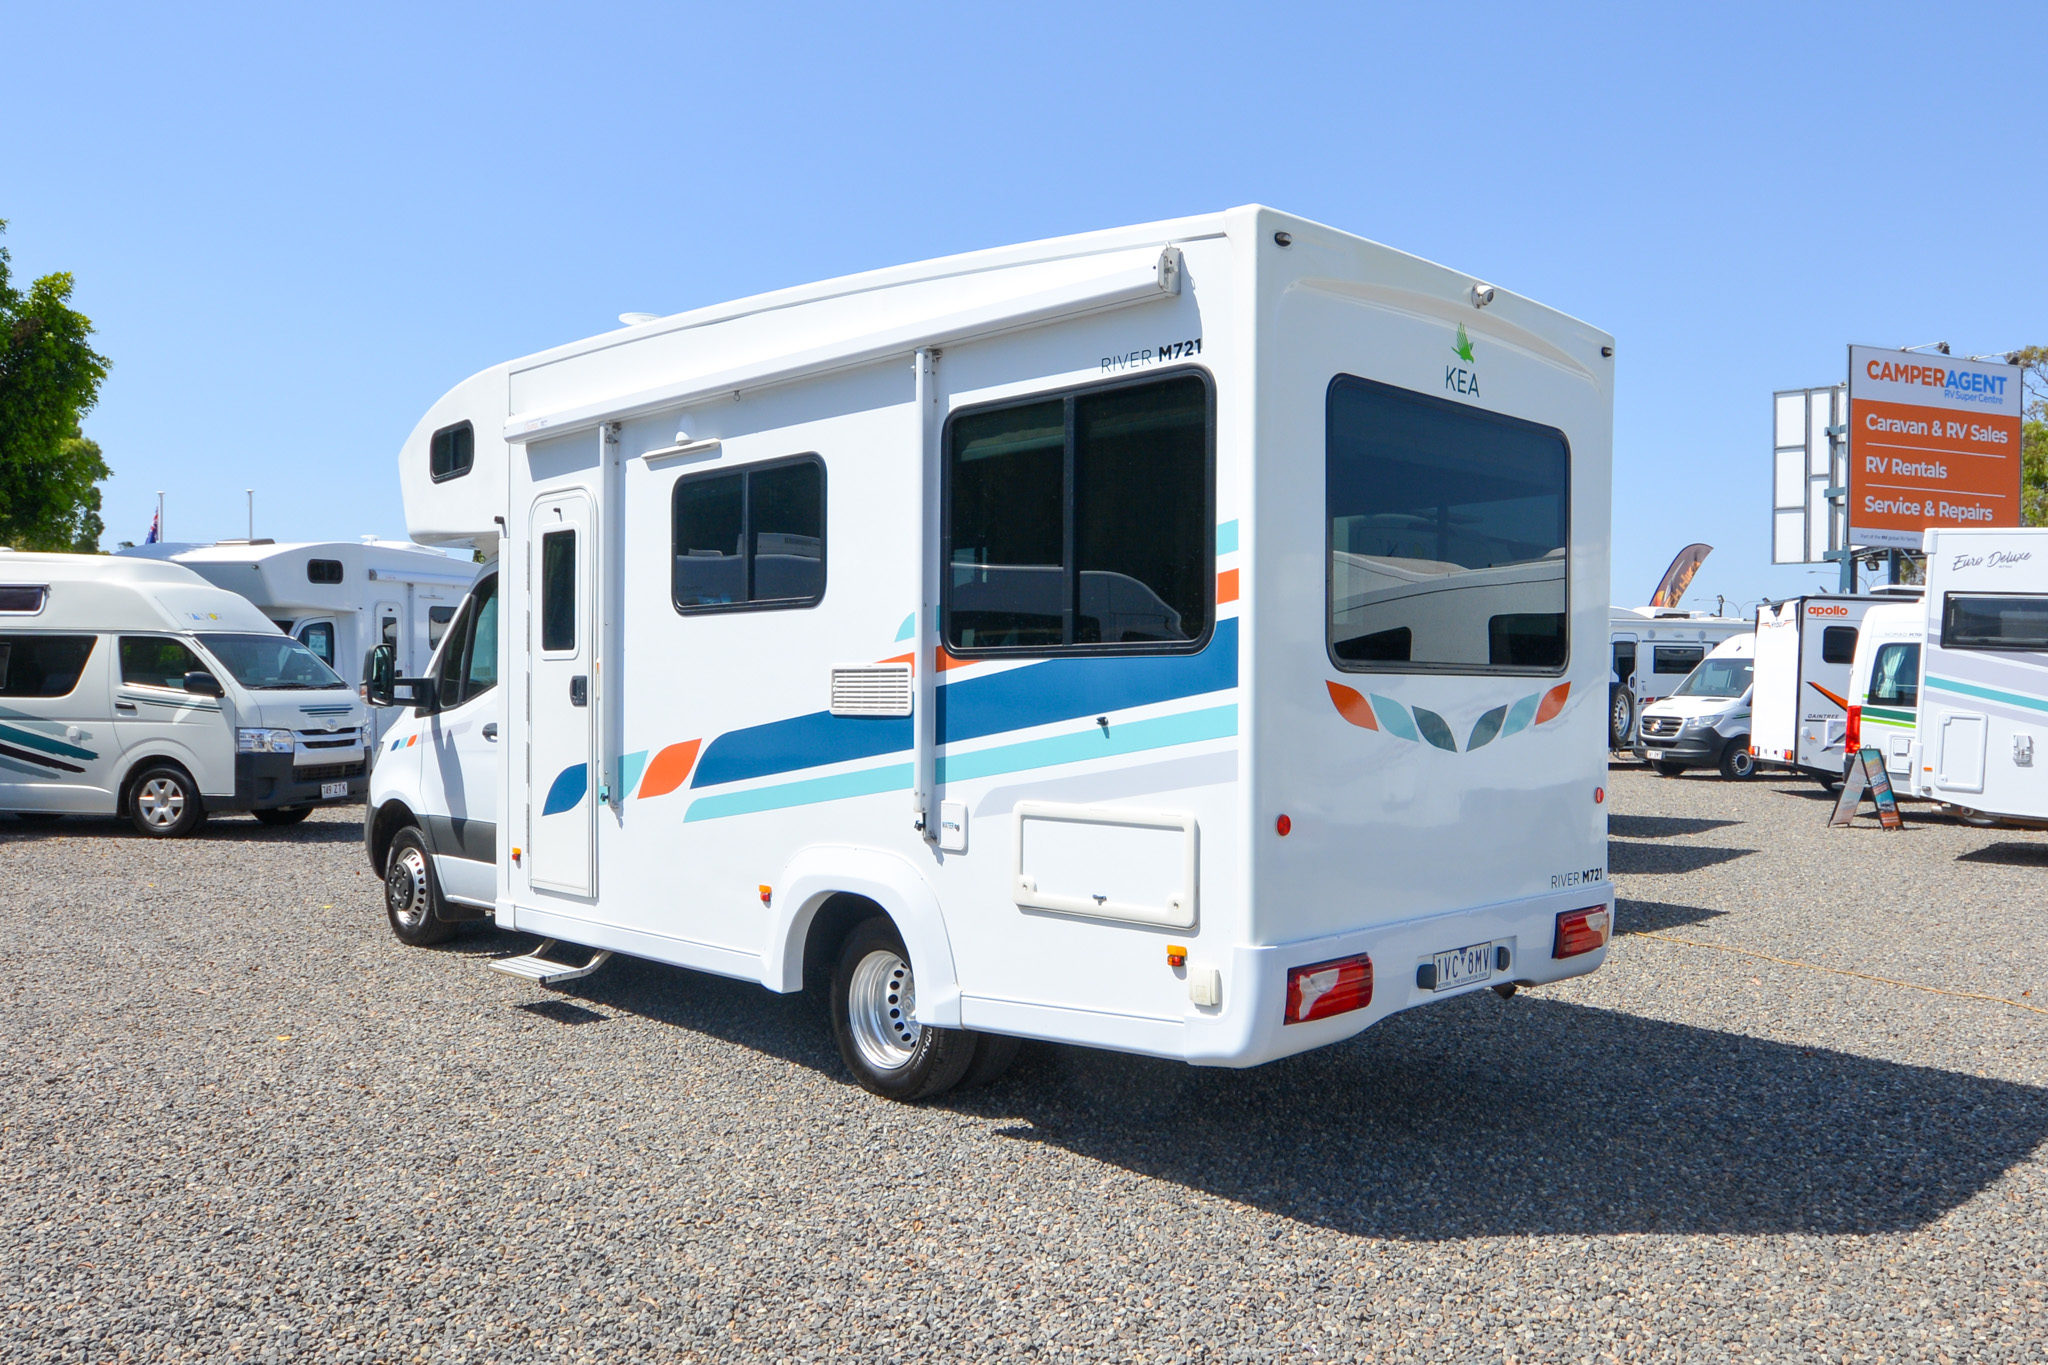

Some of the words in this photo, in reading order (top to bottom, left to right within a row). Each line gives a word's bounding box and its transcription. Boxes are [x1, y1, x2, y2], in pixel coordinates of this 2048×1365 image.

[1101, 349, 1152, 374] RIVER
[1158, 338, 1202, 362] M721
[1445, 364, 1480, 398] KEA
[1866, 359, 2008, 395] CAMPERAGENT
[1944, 389, 1956, 399] RV
[1956, 391, 1978, 402] Super
[1978, 393, 2003, 405] Centre
[1865, 413, 1928, 436] Caravan
[1931, 420, 1943, 437] &
[1946, 421, 1968, 439] RV
[1970, 424, 2008, 444] Sales
[1865, 455, 1889, 474] RV
[1891, 458, 1948, 479] Rentals
[1864, 495, 1921, 516] Service
[1923, 500, 1936, 517] &
[1938, 501, 1993, 523] Repairs
[1952, 554, 1984, 571] Euro
[1986, 550, 2032, 568] Deluxe
[1807, 605, 1849, 618] apollo
[1551, 871, 1580, 889] RIVER
[1582, 866, 1603, 884] M721
[1437, 955, 1459, 982] 1VC
[1467, 947, 1490, 975] 8MV
